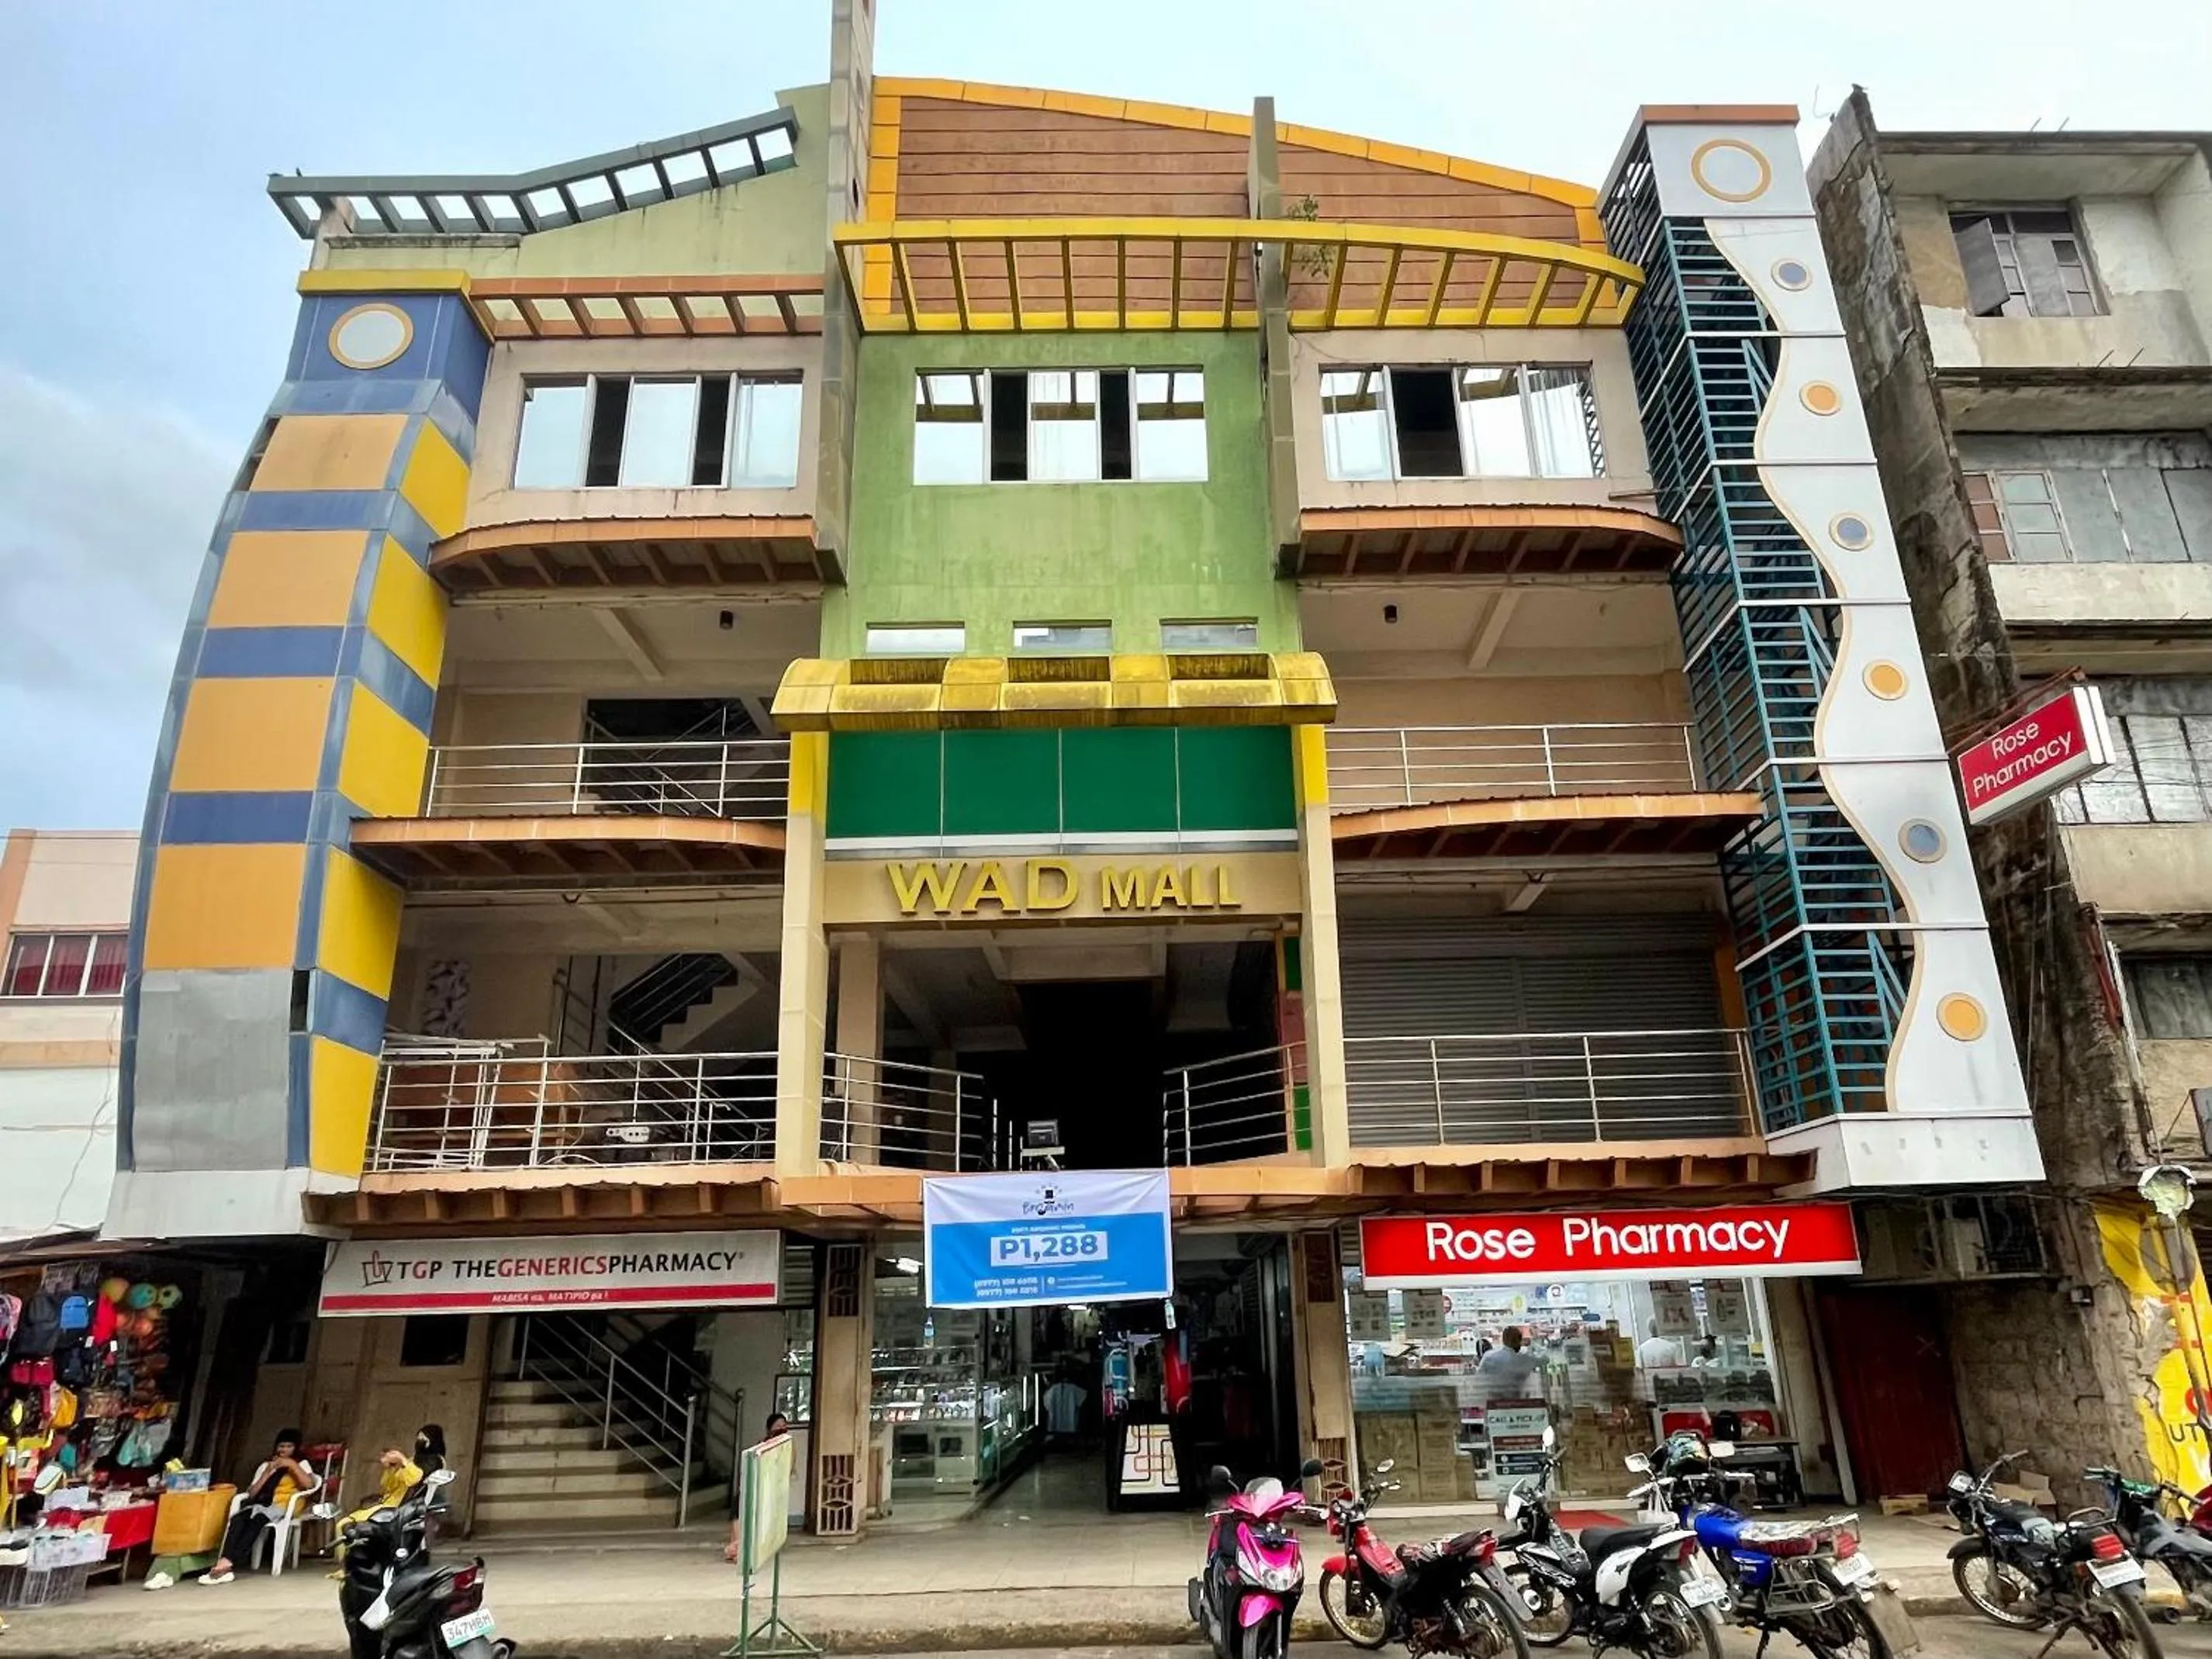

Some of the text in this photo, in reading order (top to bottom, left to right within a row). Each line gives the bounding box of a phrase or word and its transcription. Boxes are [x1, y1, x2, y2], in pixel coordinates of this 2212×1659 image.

[1991, 721, 2040, 760] Rose
[1972, 731, 2072, 798] Pharmacy
[885, 859, 1243, 915] WAD MALL
[999, 1234, 1099, 1262] P1,288
[1426, 1218, 1790, 1261] Rose Pharmacy
[397, 1261, 443, 1279] TGP
